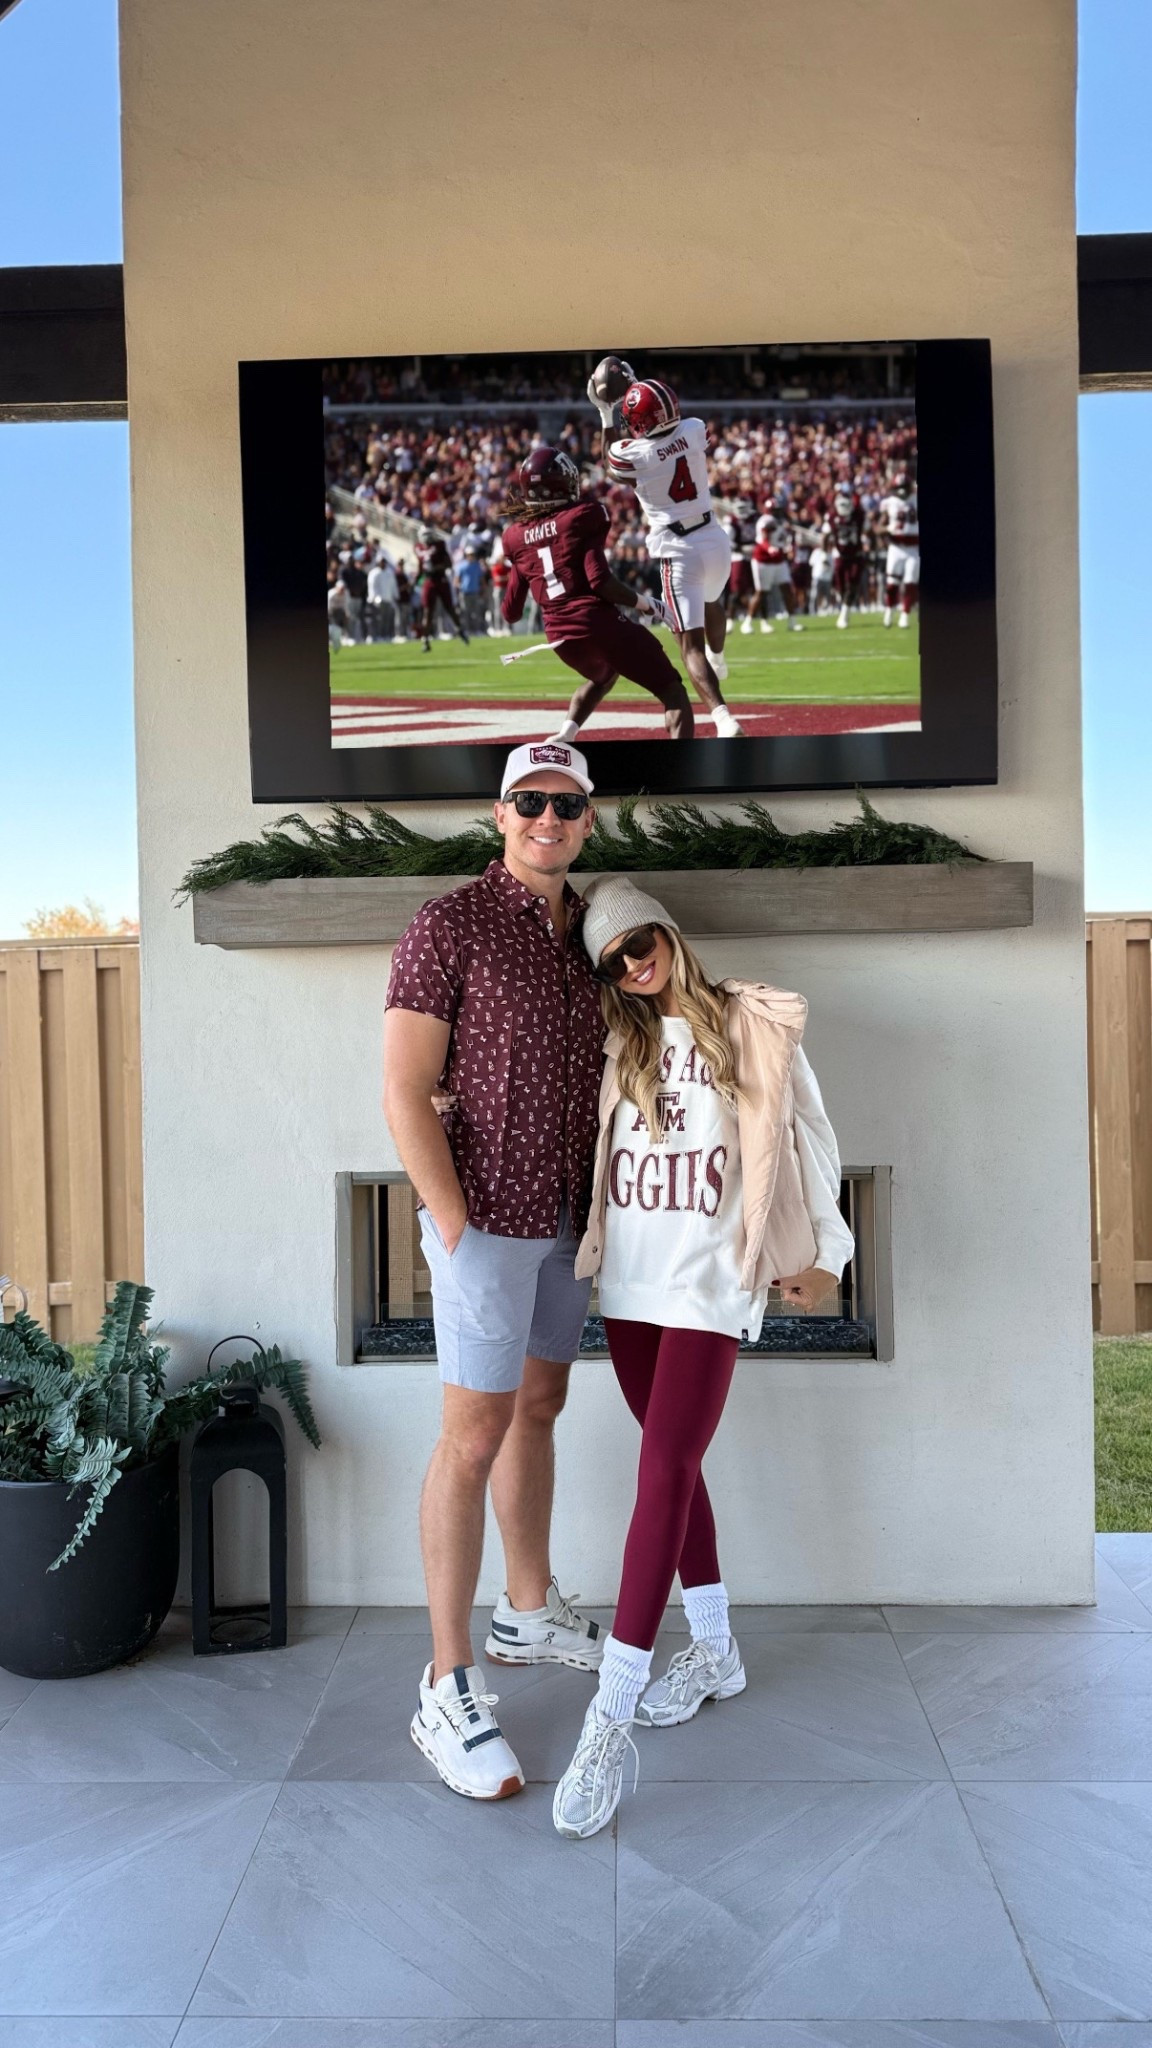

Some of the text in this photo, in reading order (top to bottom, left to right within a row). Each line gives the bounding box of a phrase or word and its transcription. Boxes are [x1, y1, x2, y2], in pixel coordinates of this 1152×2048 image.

[656, 437, 689, 461] SWAIN
[668, 455, 698, 504] 4
[523, 520, 558, 545] CRAVER
[537, 546, 566, 600] 1
[607, 1145, 728, 1217] GGIES
